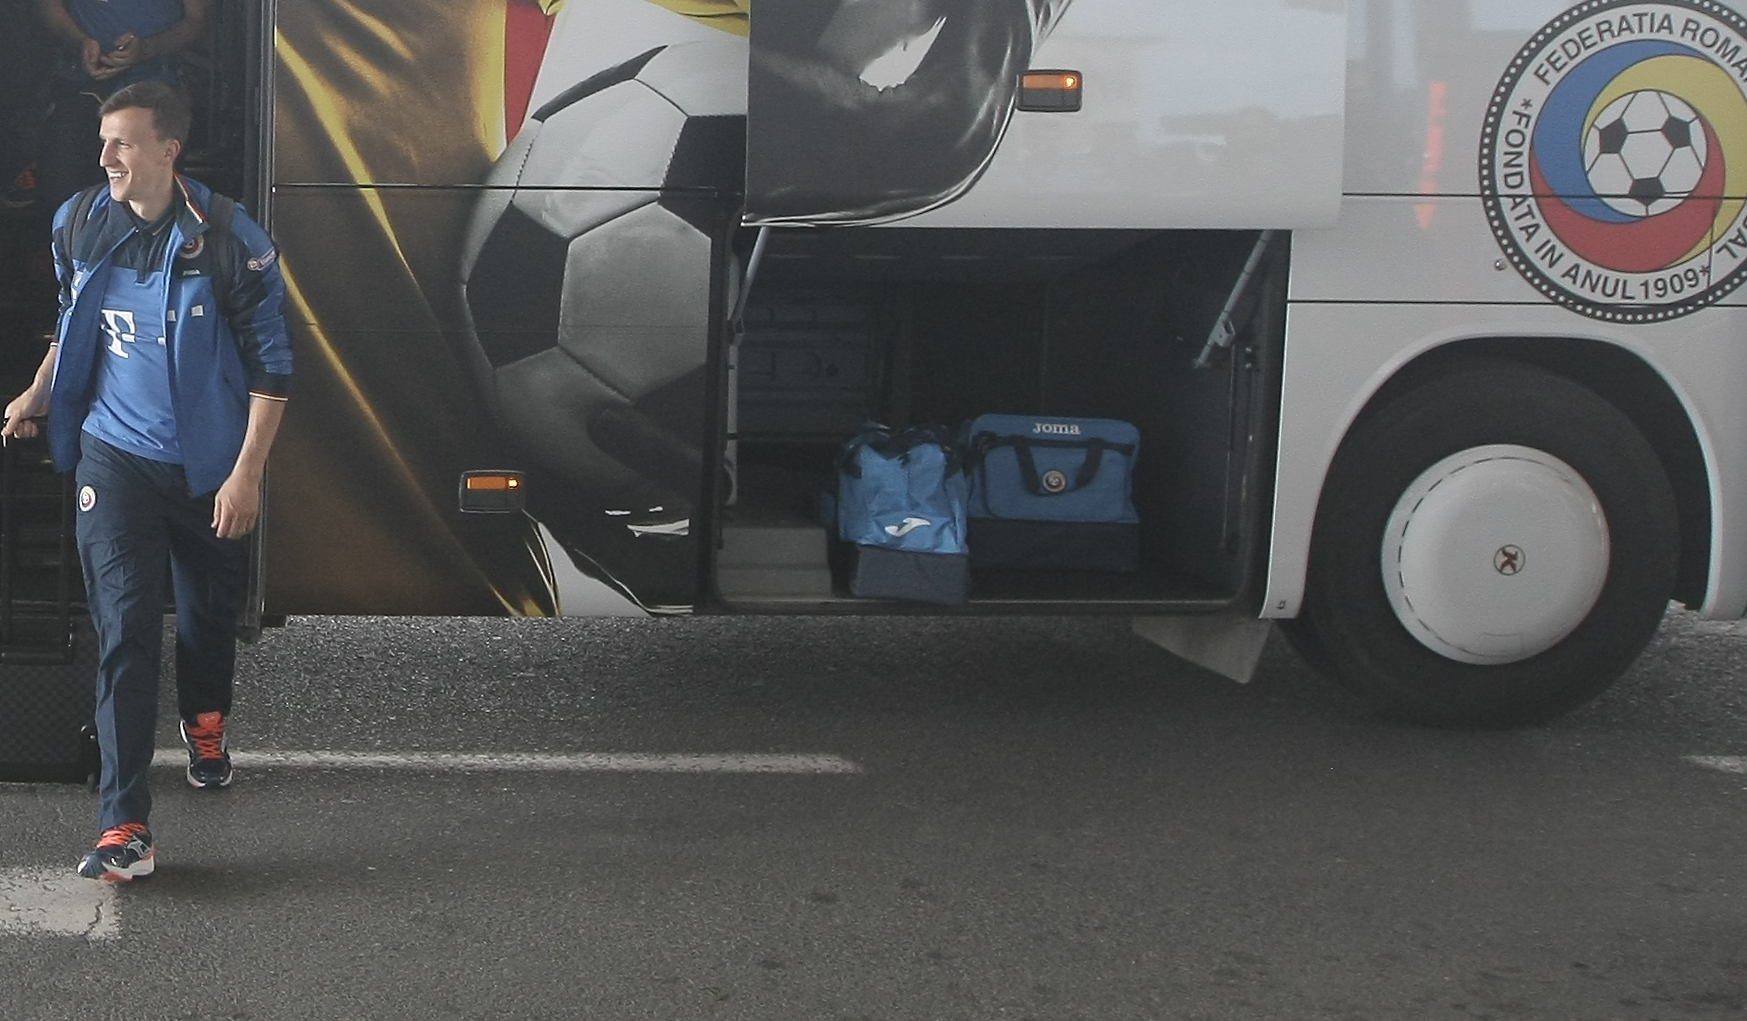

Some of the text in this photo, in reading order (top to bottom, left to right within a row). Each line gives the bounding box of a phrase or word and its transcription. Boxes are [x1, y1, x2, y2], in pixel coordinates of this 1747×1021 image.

[1533, 12, 1675, 87] FEDERATIA
[1679, 17, 1747, 85] ROMA
[1533, 237, 1566, 270] IN
[1560, 261, 1636, 301] ANUL
